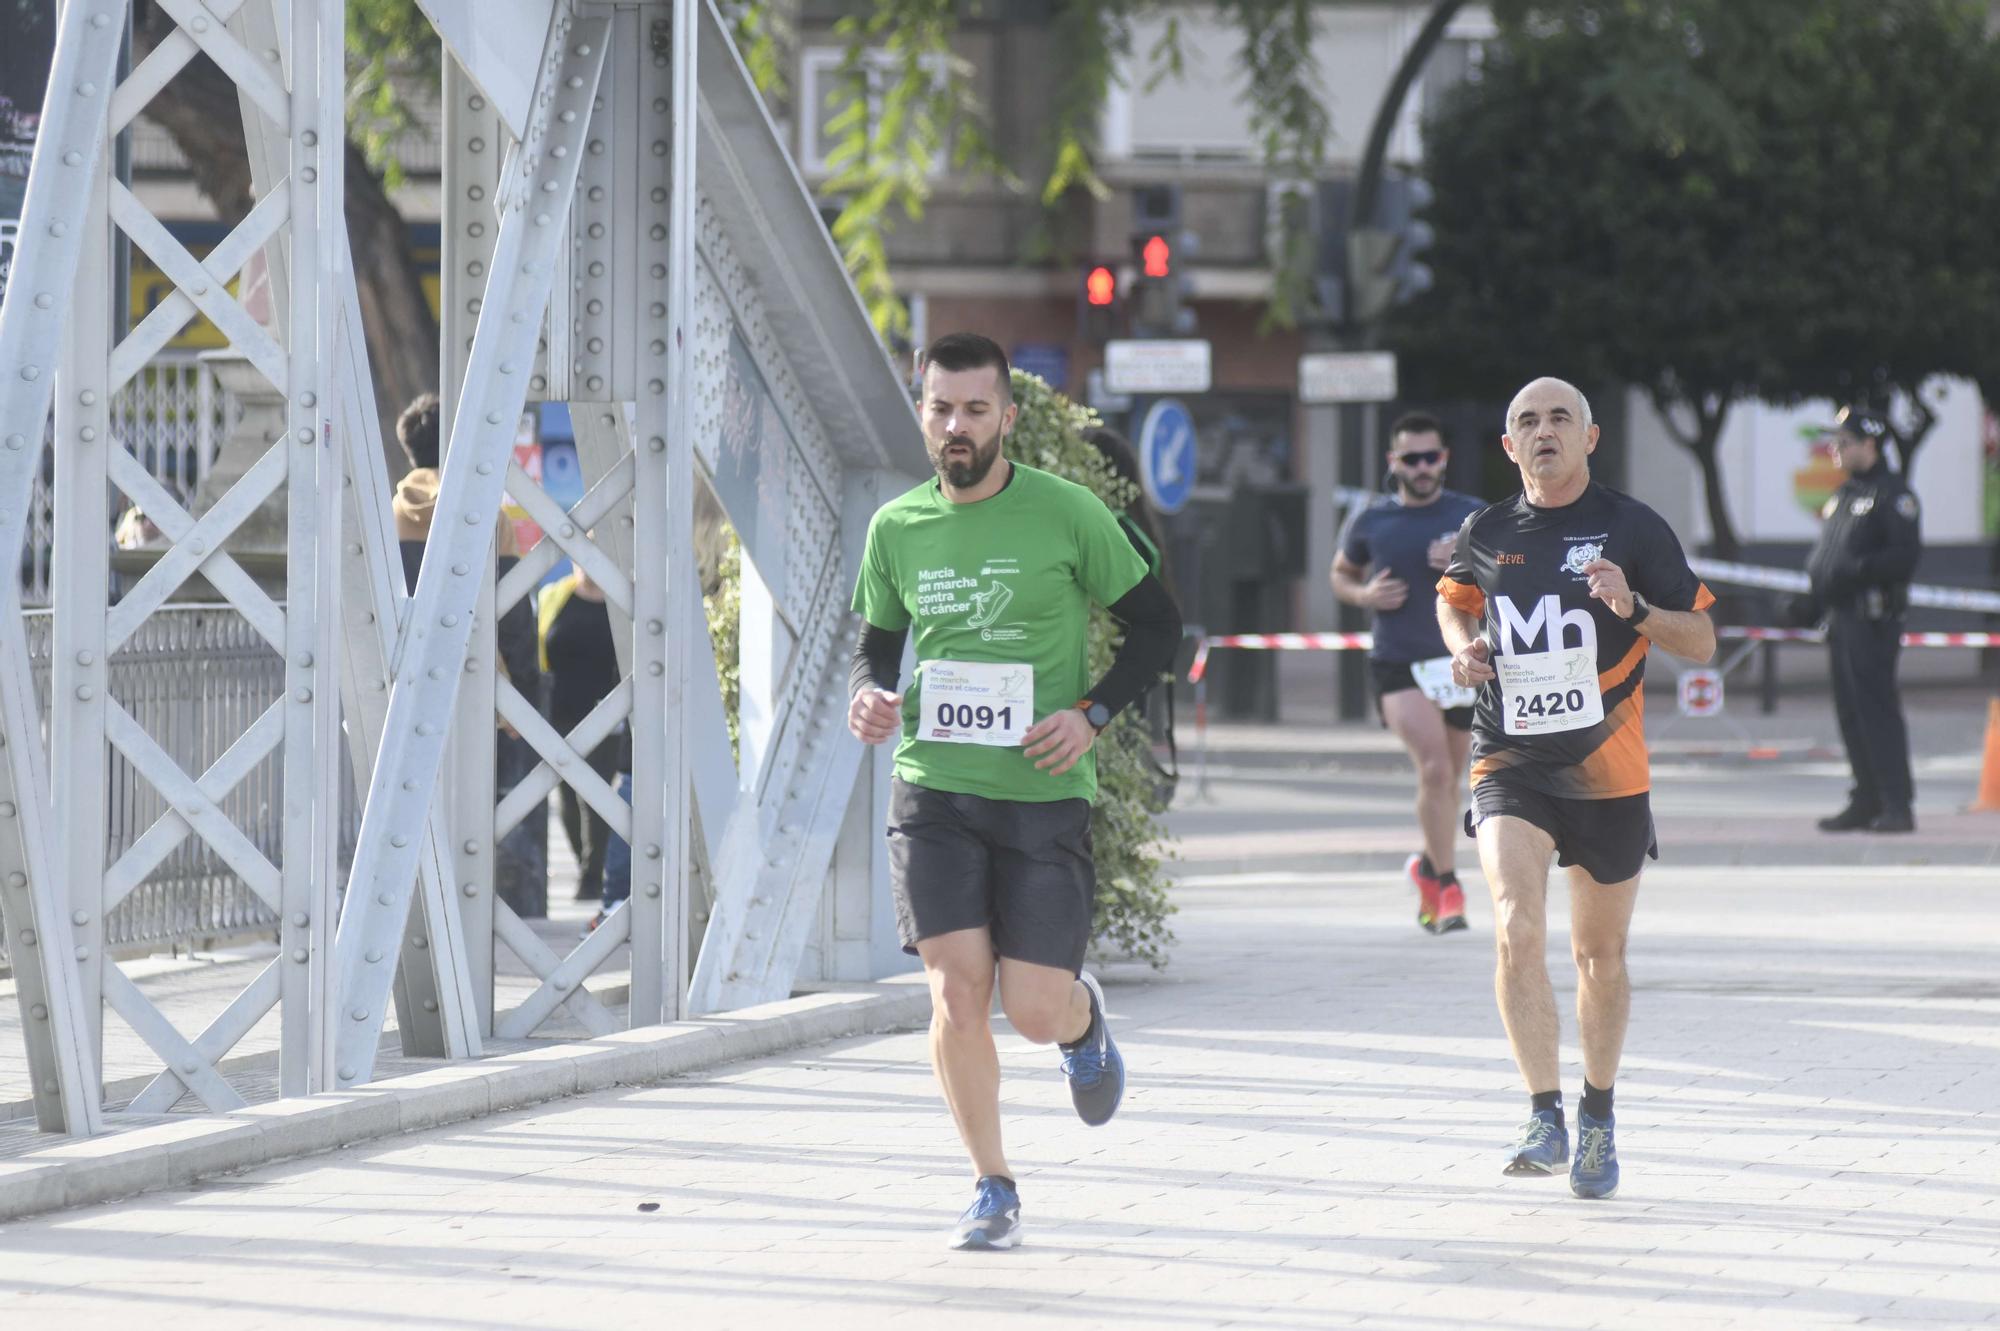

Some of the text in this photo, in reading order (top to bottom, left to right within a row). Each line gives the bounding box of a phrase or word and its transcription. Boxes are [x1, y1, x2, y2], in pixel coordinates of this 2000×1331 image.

[918, 567, 955, 581] Murcia
[918, 577, 978, 593] en marcha
[918, 591, 954, 604] contra
[920, 601, 971, 616] el cáncer
[930, 667, 954, 676] Murcia
[940, 676, 969, 684] marcha
[1531, 674, 1556, 683] cáncer
[929, 683, 953, 691] contra
[963, 684, 990, 693] cáncer
[1515, 689, 1584, 718] 2420
[937, 703, 1011, 730] 0091
